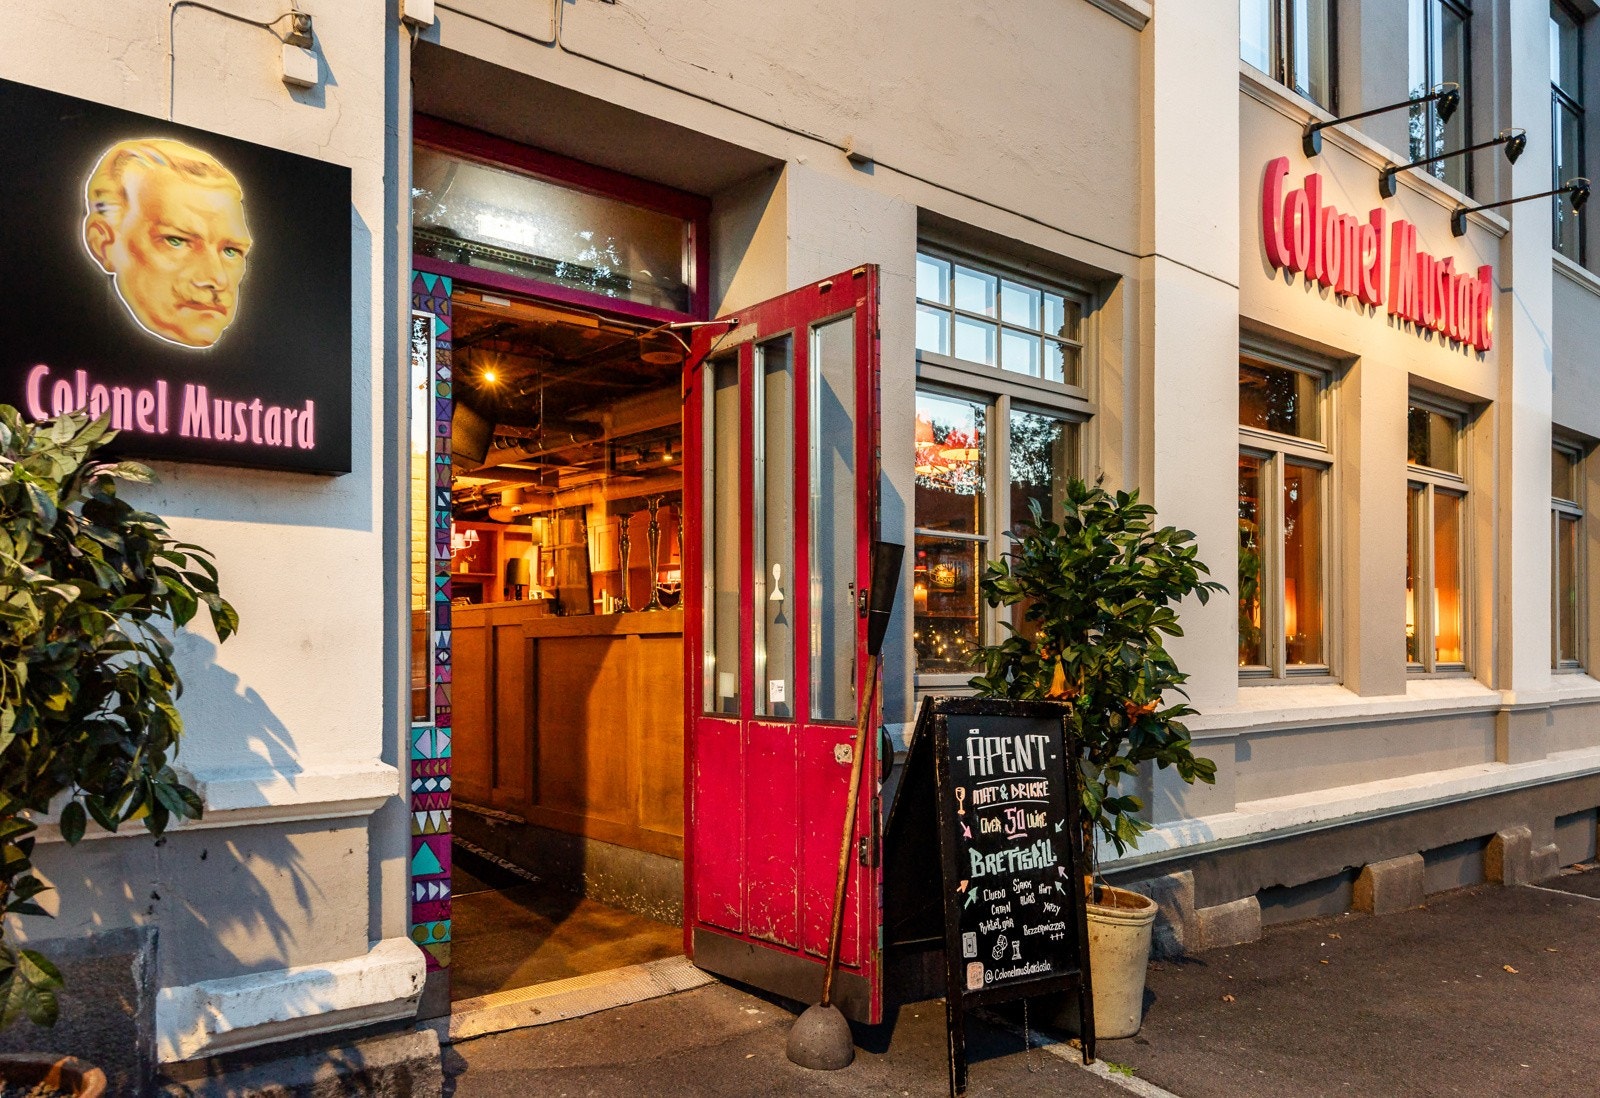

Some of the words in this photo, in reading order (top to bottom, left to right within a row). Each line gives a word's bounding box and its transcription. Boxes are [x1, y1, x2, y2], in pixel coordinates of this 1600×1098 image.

[1262, 156, 1387, 306] Colonel
[1387, 219, 1493, 352] Mustard
[26, 364, 168, 434] Colonel
[179, 384, 315, 449] Mustard
[966, 729, 1050, 776] ÅPENT
[972, 786, 999, 805] MAT
[999, 783, 1009, 801] &
[1010, 780, 1050, 800] DRIKKE
[1003, 806, 1026, 835] 50
